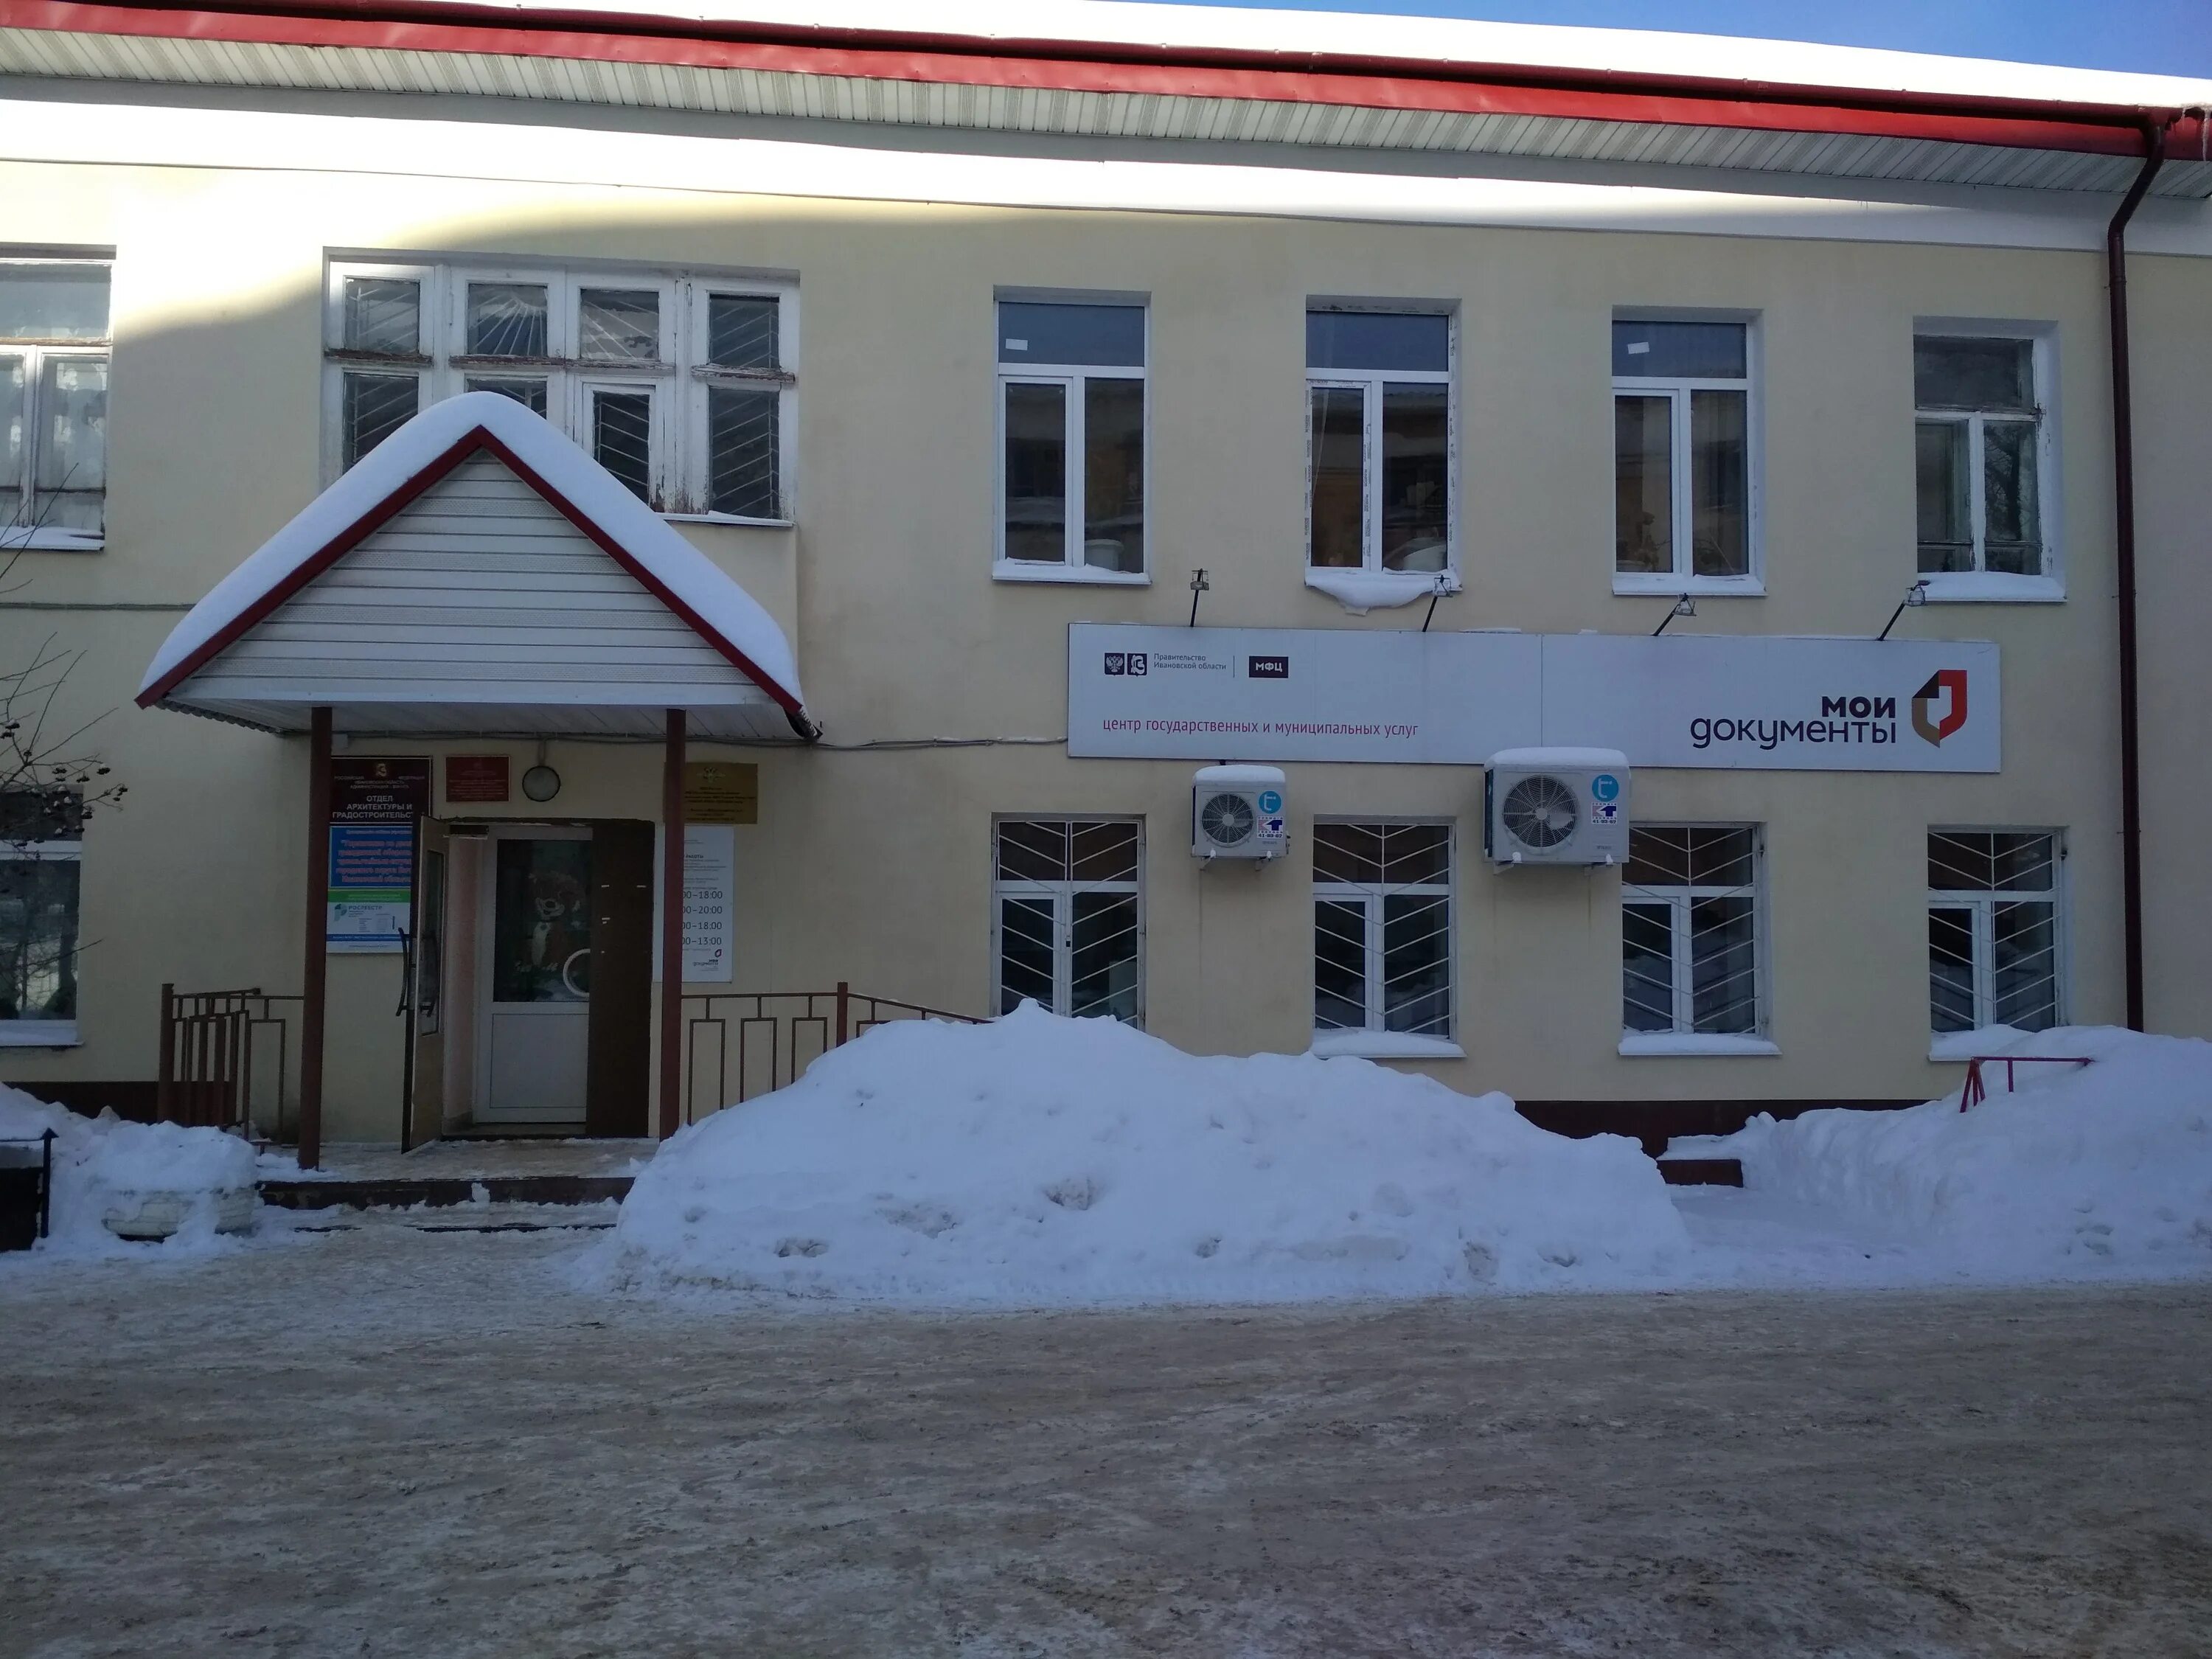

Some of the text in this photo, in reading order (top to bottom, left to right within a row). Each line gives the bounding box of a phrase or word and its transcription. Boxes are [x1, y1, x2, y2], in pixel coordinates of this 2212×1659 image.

[1154, 653, 1206, 661] Правительство
[1154, 661, 1227, 670] Ивановской области
[1256, 662, 1283, 672] МФЦ
[1821, 696, 1896, 718] мои
[1103, 719, 1419, 739] центр государственных и муниципальных услуг
[1690, 717, 1896, 751] документы
[366, 795, 393, 803] ОТДЕЛ
[332, 811, 413, 819] ГРАДОСТРОИТЕЛЬС
